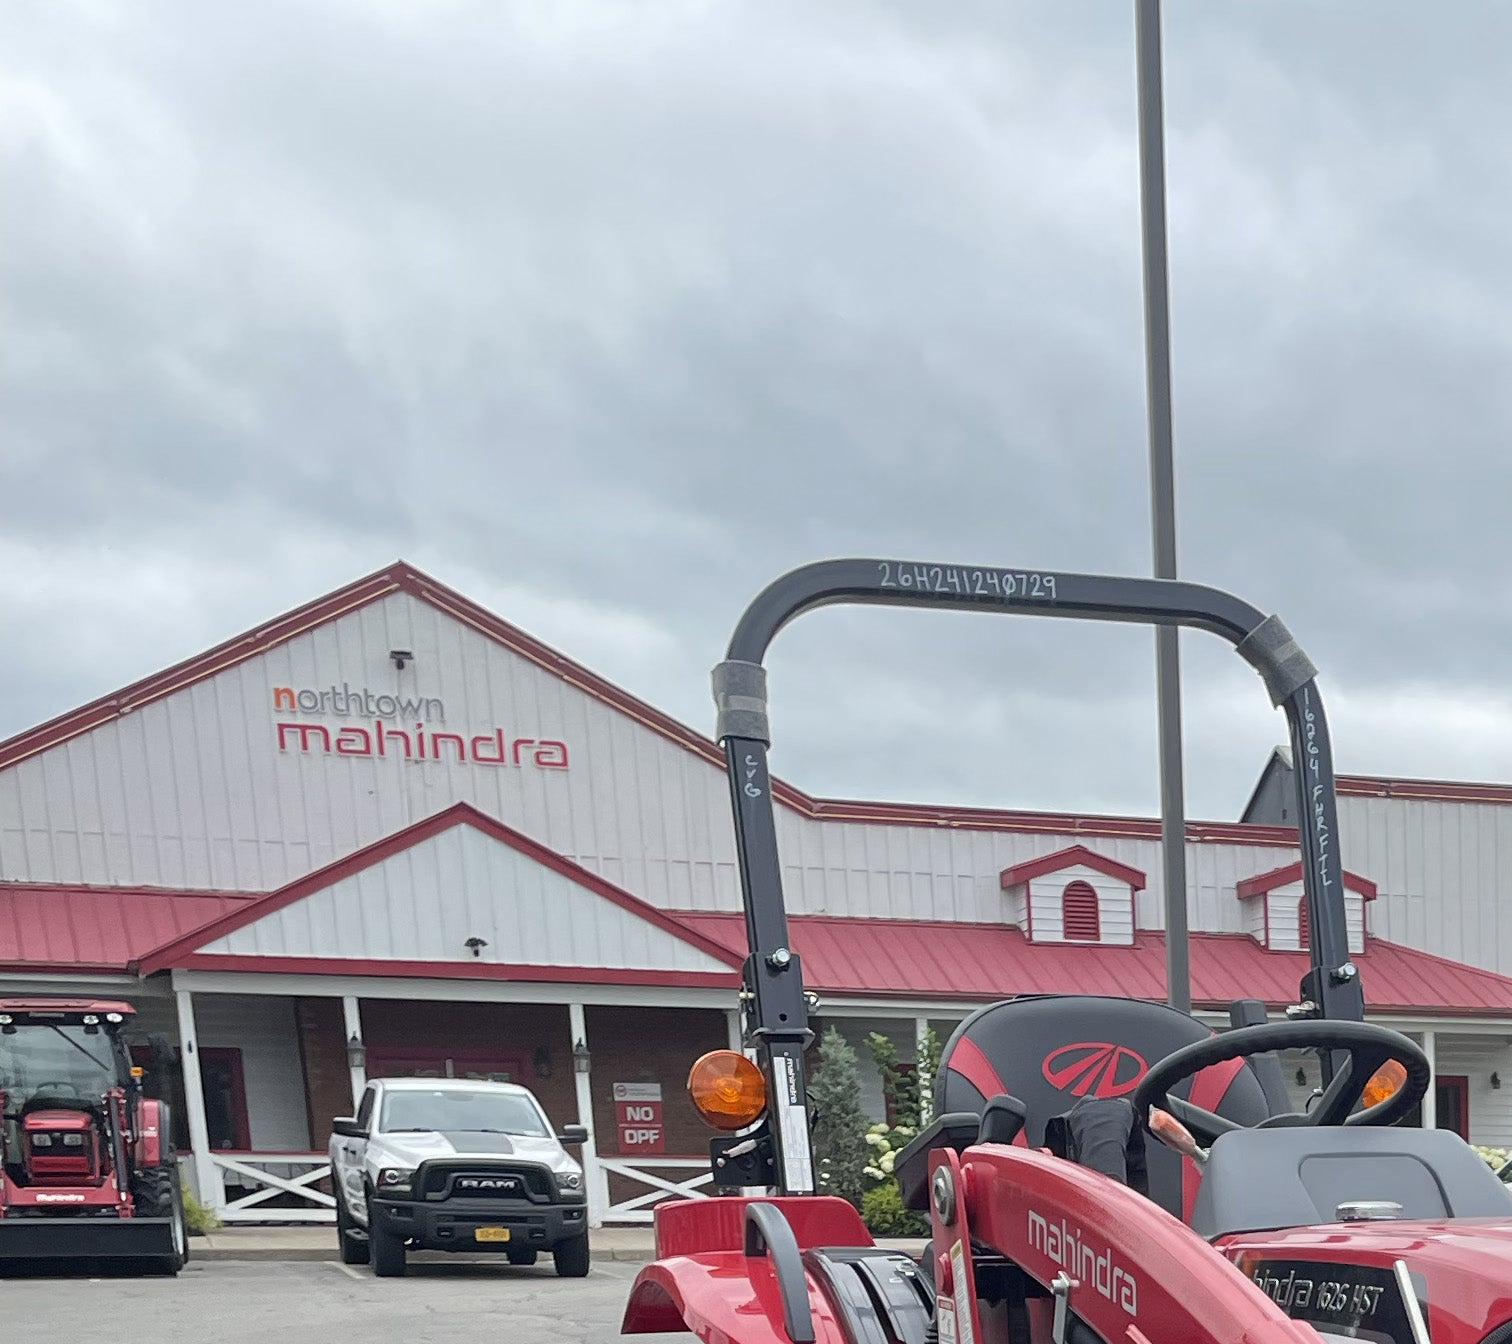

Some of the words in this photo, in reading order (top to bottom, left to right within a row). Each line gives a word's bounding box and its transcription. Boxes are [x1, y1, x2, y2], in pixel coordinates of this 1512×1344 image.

[878, 563, 1056, 599] 26H241240729
[273, 684, 446, 721] northtown
[276, 720, 570, 769] mahindra
[626, 1106, 654, 1121] NO
[461, 1180, 515, 1189] RAM
[1028, 1210, 1137, 1317] mahindra
[1316, 1281, 1350, 1311] 1626
[1350, 1284, 1385, 1316] HST
